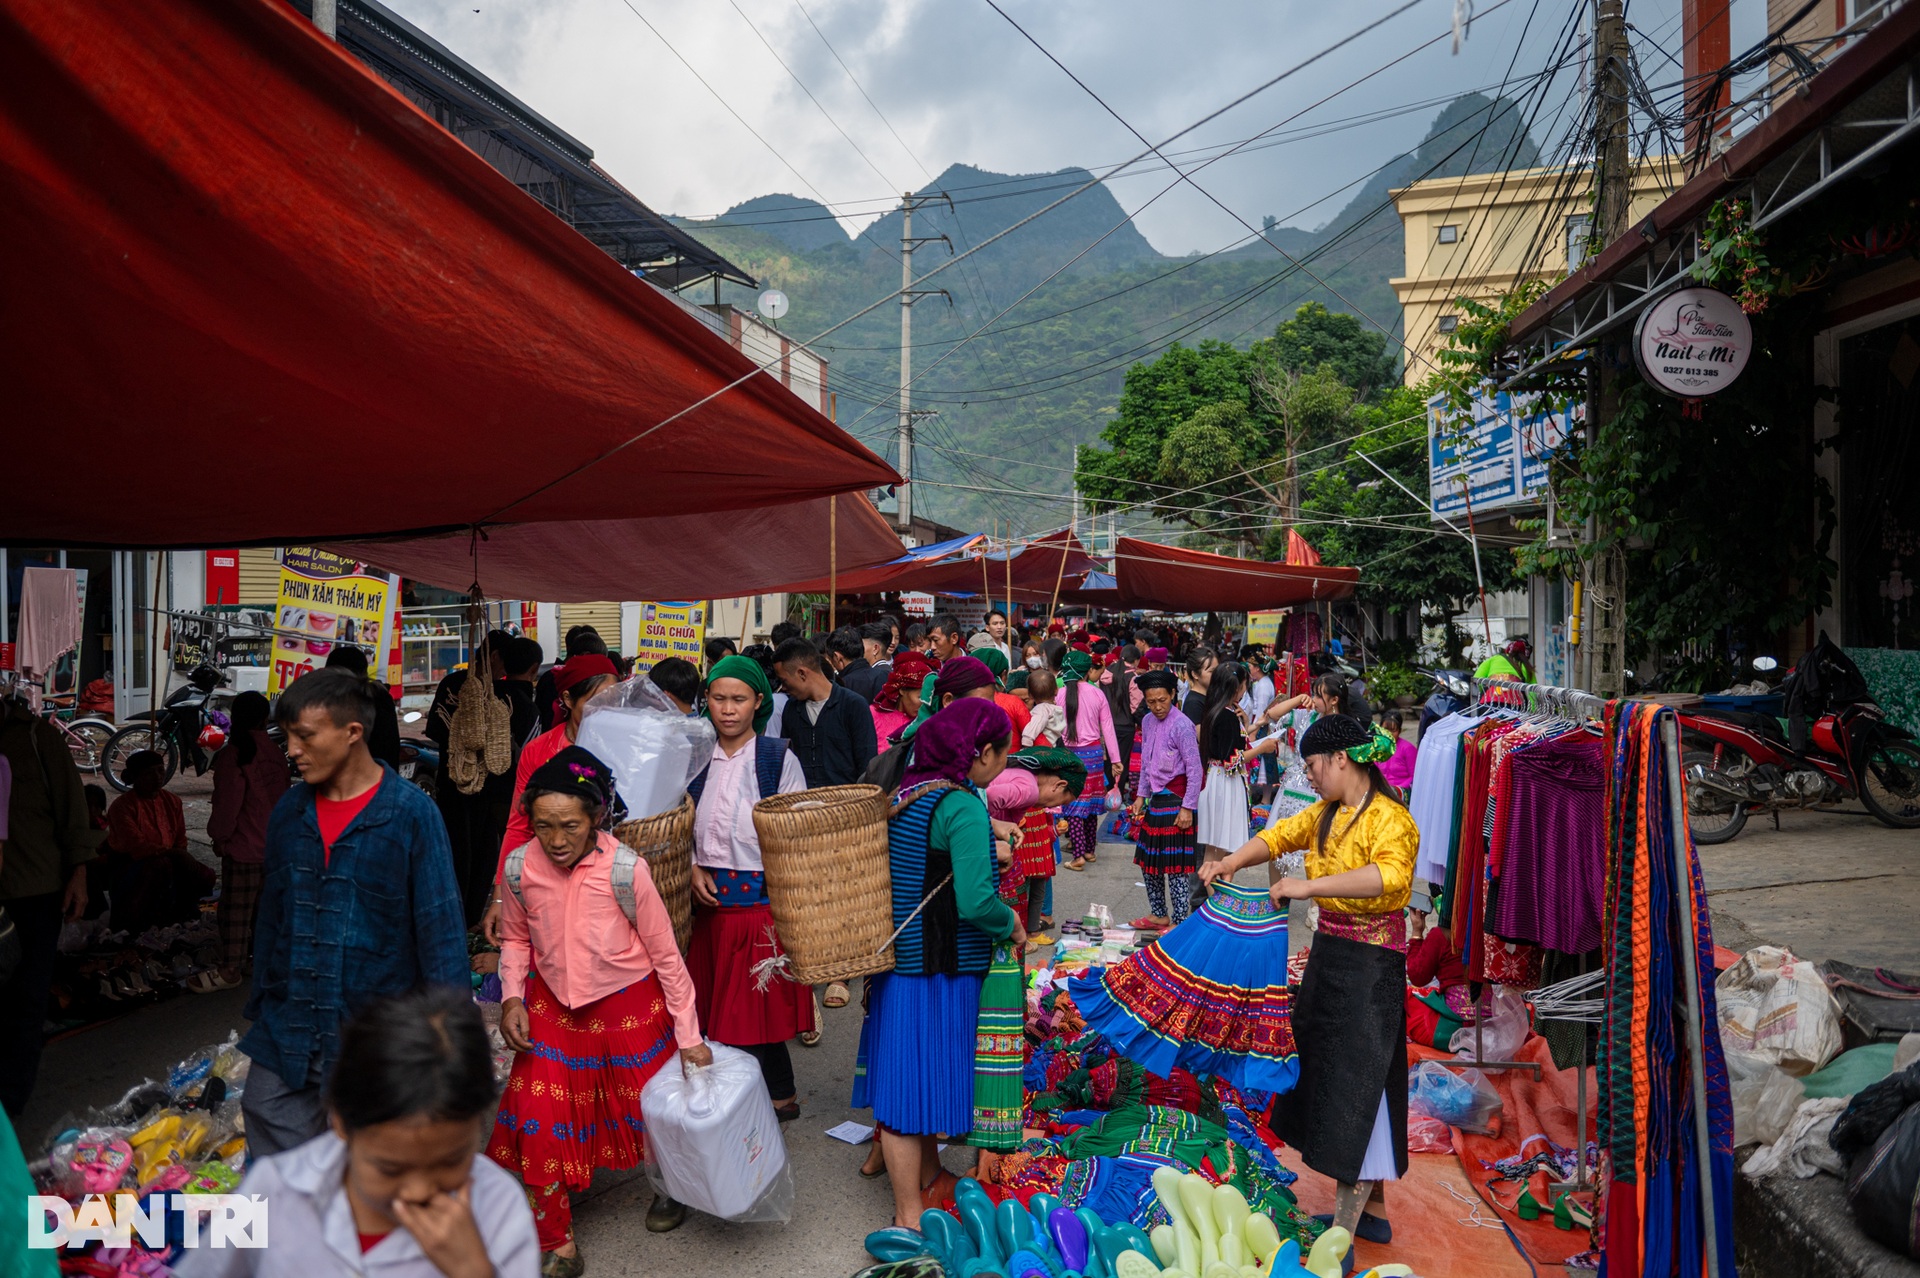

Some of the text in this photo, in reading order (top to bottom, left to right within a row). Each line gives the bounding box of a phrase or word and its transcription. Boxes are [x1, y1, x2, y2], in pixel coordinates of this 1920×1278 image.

[1655, 342, 1693, 361] Nail
[1709, 346, 1735, 363] Mi
[1663, 366, 1719, 377] 0327 613 385
[287, 559, 342, 574] HAIR SALON
[312, 582, 334, 604] XĂM
[366, 591, 382, 612] MỸ
[658, 612, 685, 621] CHUYÊN
[646, 621, 695, 639] SỬA CHỮA
[640, 638, 653, 648] MUA
[655, 639, 667, 649] BÁN
[673, 641, 688, 651] TRAO
